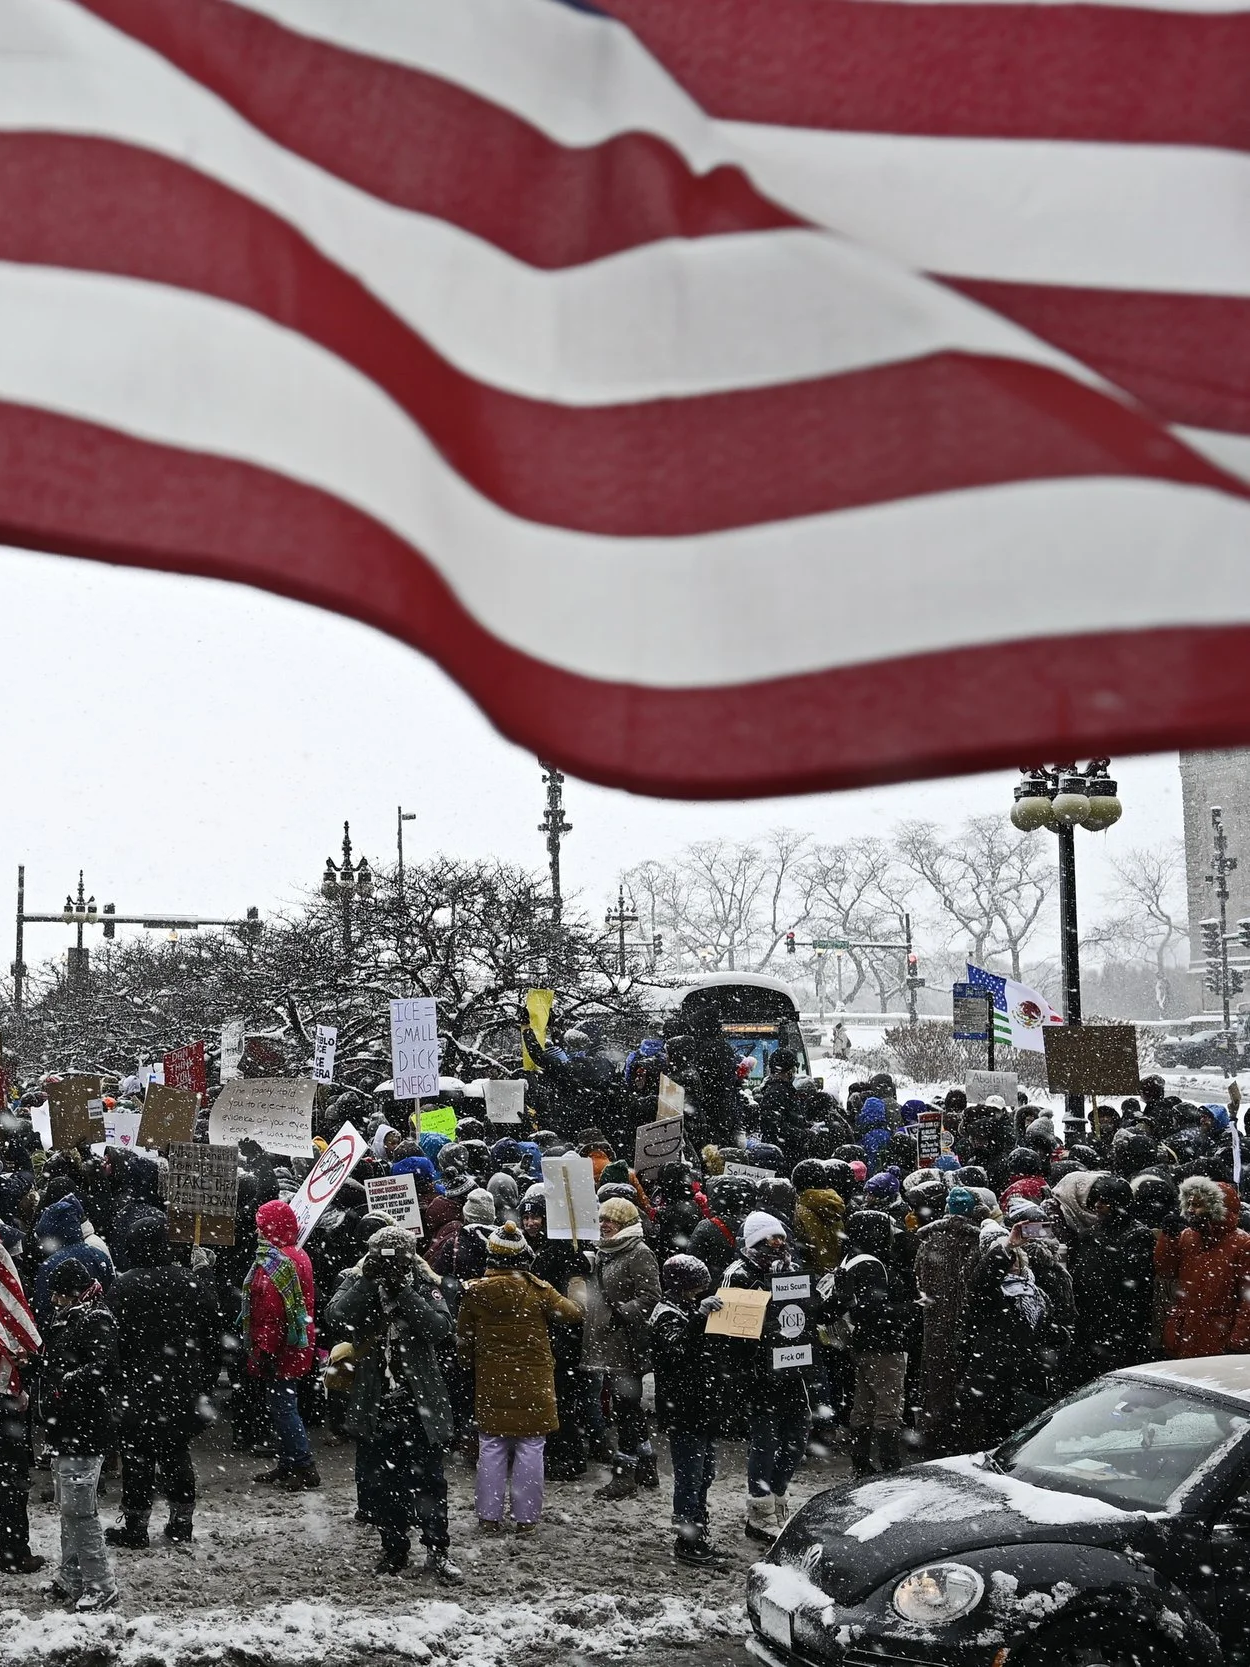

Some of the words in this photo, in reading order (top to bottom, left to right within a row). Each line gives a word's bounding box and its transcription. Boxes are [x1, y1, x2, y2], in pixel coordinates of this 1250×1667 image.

[394, 1002, 420, 1022] ICE
[396, 1024, 434, 1044] SMALL
[973, 1072, 1005, 1083] Abolish
[396, 1074, 438, 1097] ENERGY
[251, 1087, 274, 1097] party
[277, 1087, 297, 1098] told
[228, 1100, 244, 1109] you
[256, 1102, 286, 1113] reject
[288, 1104, 305, 1116] the
[257, 1115, 268, 1123] of
[270, 1119, 285, 1129] your
[289, 1121, 309, 1132] eyes
[170, 1173, 212, 1190] TAKE
[385, 1184, 409, 1193] BUSINESSES
[375, 1194, 388, 1202] BROAD
[389, 1192, 407, 1200] DAYLIGHT
[371, 1202, 388, 1210] DOESN'T
[399, 1198, 415, 1206] ALARMS
[775, 1284, 789, 1292] Nazi
[790, 1283, 807, 1291] Scum
[781, 1313, 804, 1327] ICE
[795, 1352, 805, 1360] Off
